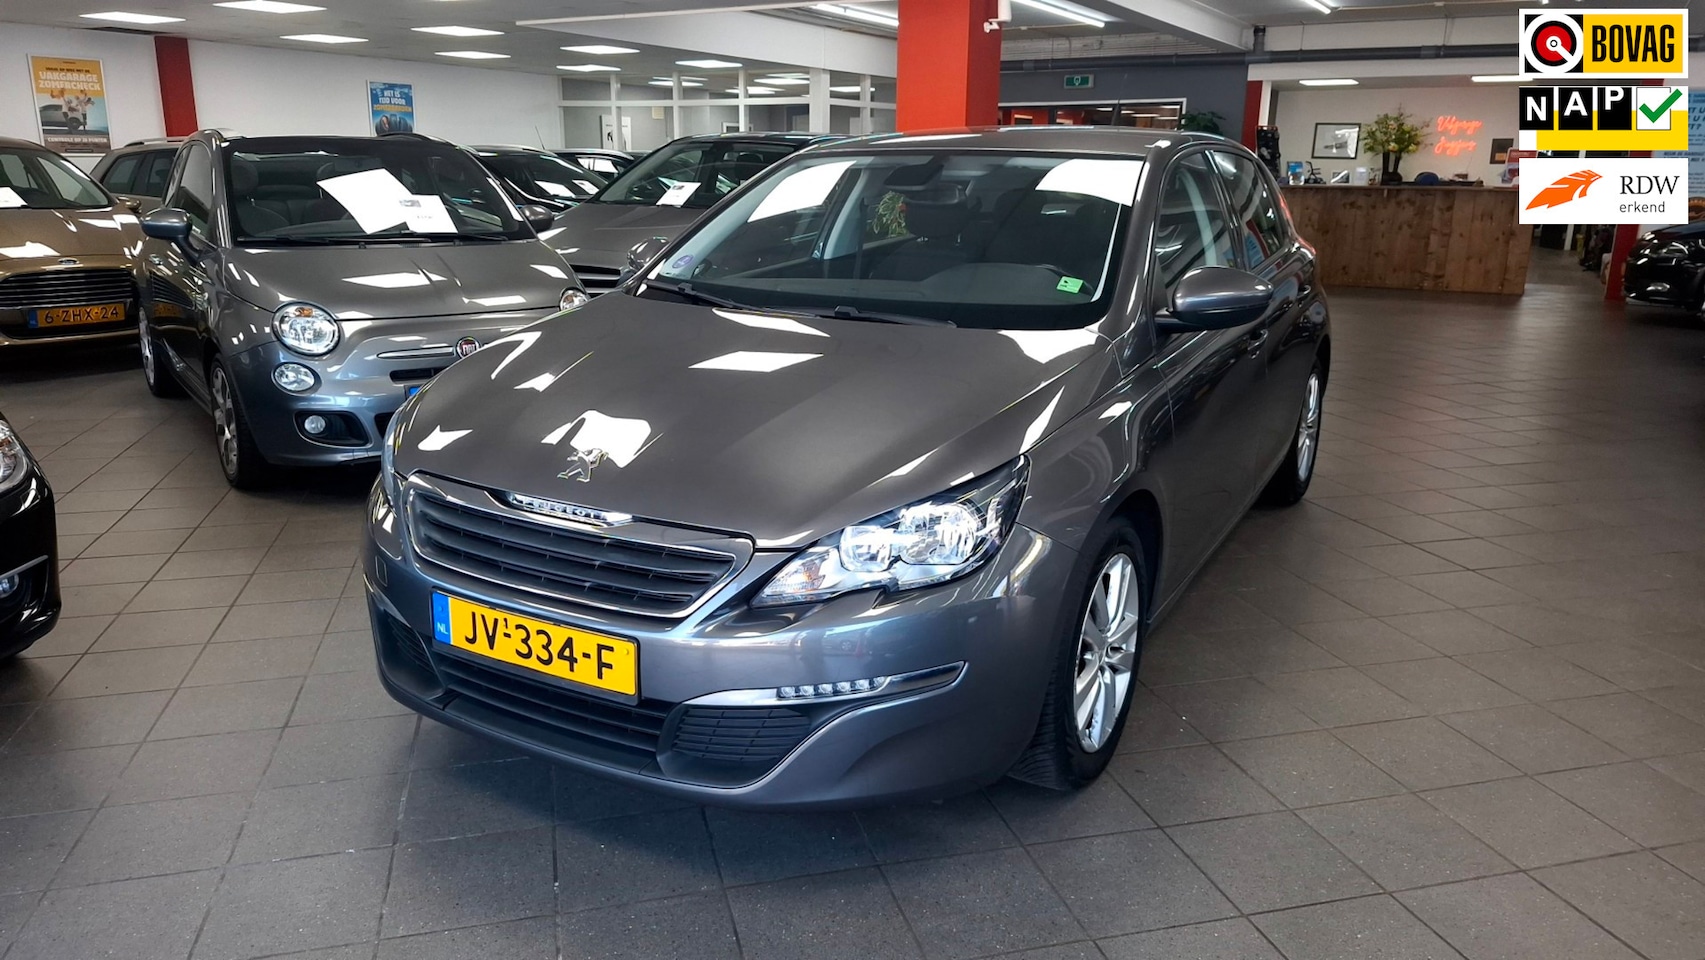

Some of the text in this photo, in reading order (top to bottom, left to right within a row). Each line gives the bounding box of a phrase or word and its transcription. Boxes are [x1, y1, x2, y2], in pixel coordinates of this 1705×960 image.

[39, 71, 98, 82] VAKGARAGE
[44, 305, 119, 324] 6-ZHX-24
[436, 621, 449, 636] NL
